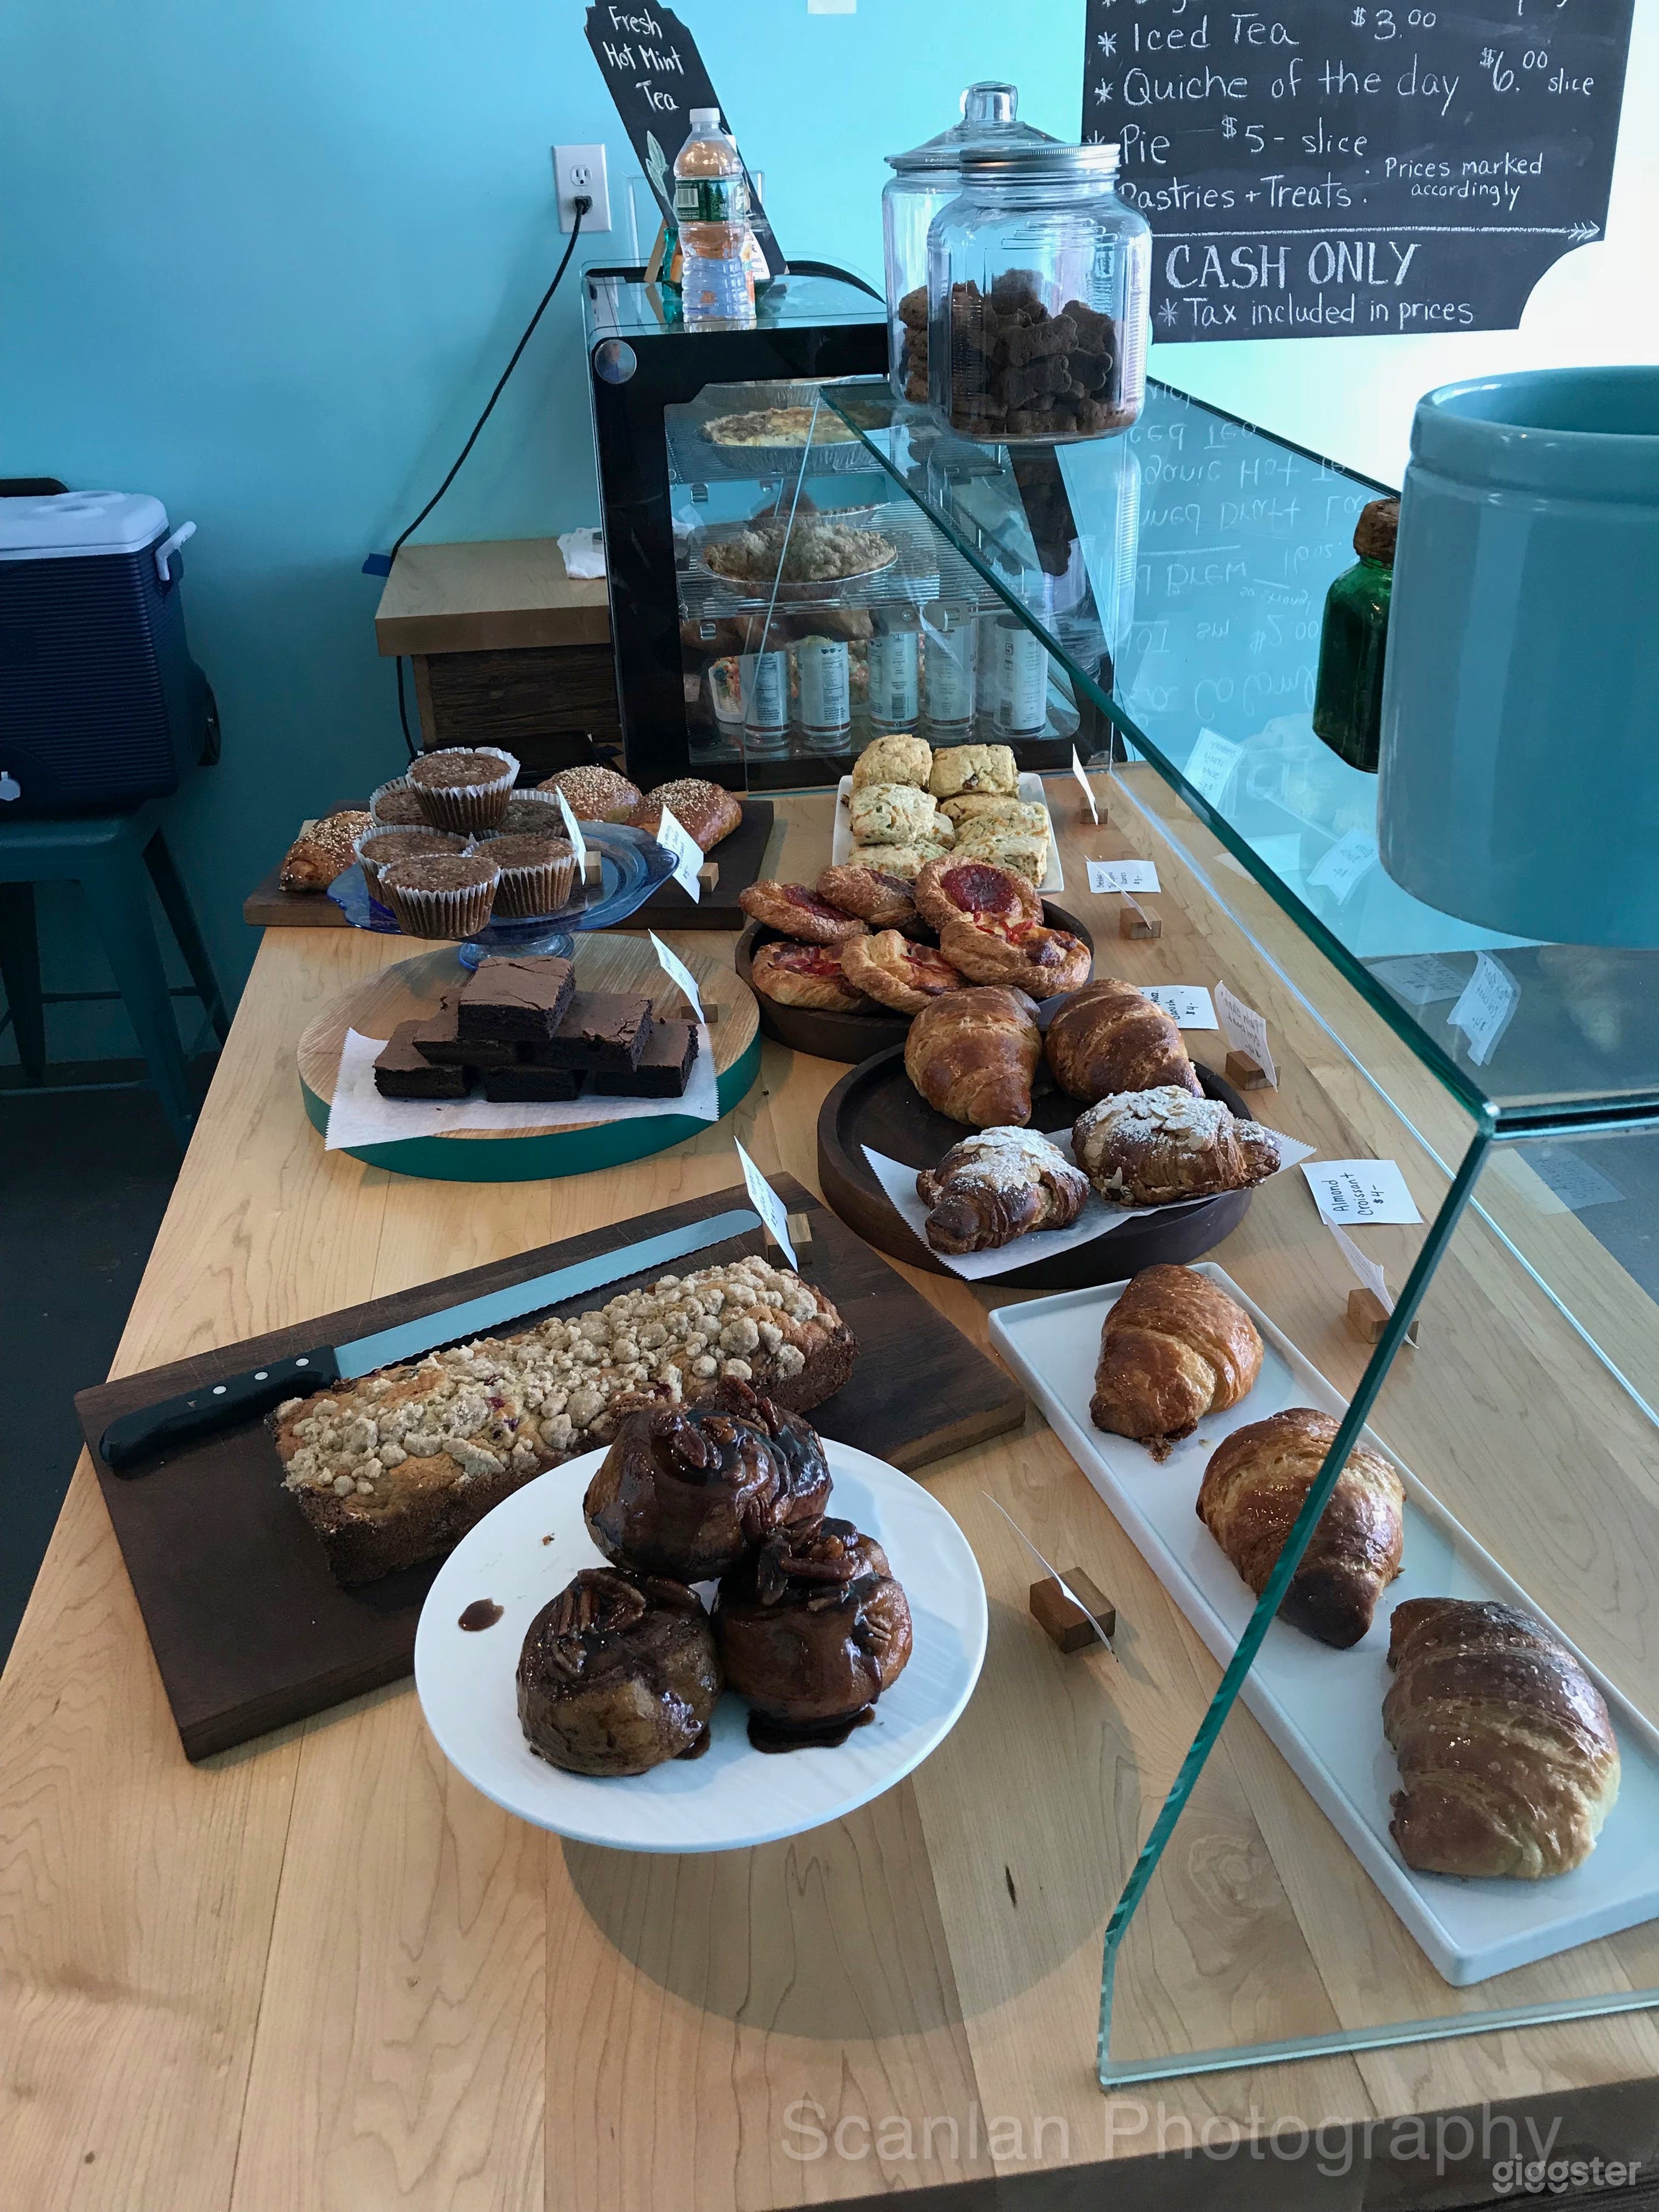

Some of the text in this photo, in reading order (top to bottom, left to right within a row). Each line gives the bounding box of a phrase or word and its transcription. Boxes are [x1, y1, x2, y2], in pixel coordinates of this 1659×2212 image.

[608, 5, 663, 40] Fresh
[1134, 6, 1437, 52] Iced Tea $3.00
[603, 41, 685, 75] Hot Mint
[635, 79, 680, 112] Tea
[1124, 66, 1248, 106] Quiche
[1271, 56, 1304, 100] of
[1319, 54, 1382, 96] the
[1397, 56, 1460, 115] day
[1548, 70, 1595, 97] slice
[1119, 123, 1171, 165] Pie
[1301, 116, 1368, 156] slice
[1384, 152, 1543, 179] Prices marked
[1411, 180, 1521, 211] accordingly
[1165, 240, 1422, 289] CASH ONLY
[1179, 291, 1475, 332] Tax included in prices
[1321, 1179, 1350, 1212] Almond
[1370, 1184, 1385, 1205] $4-
